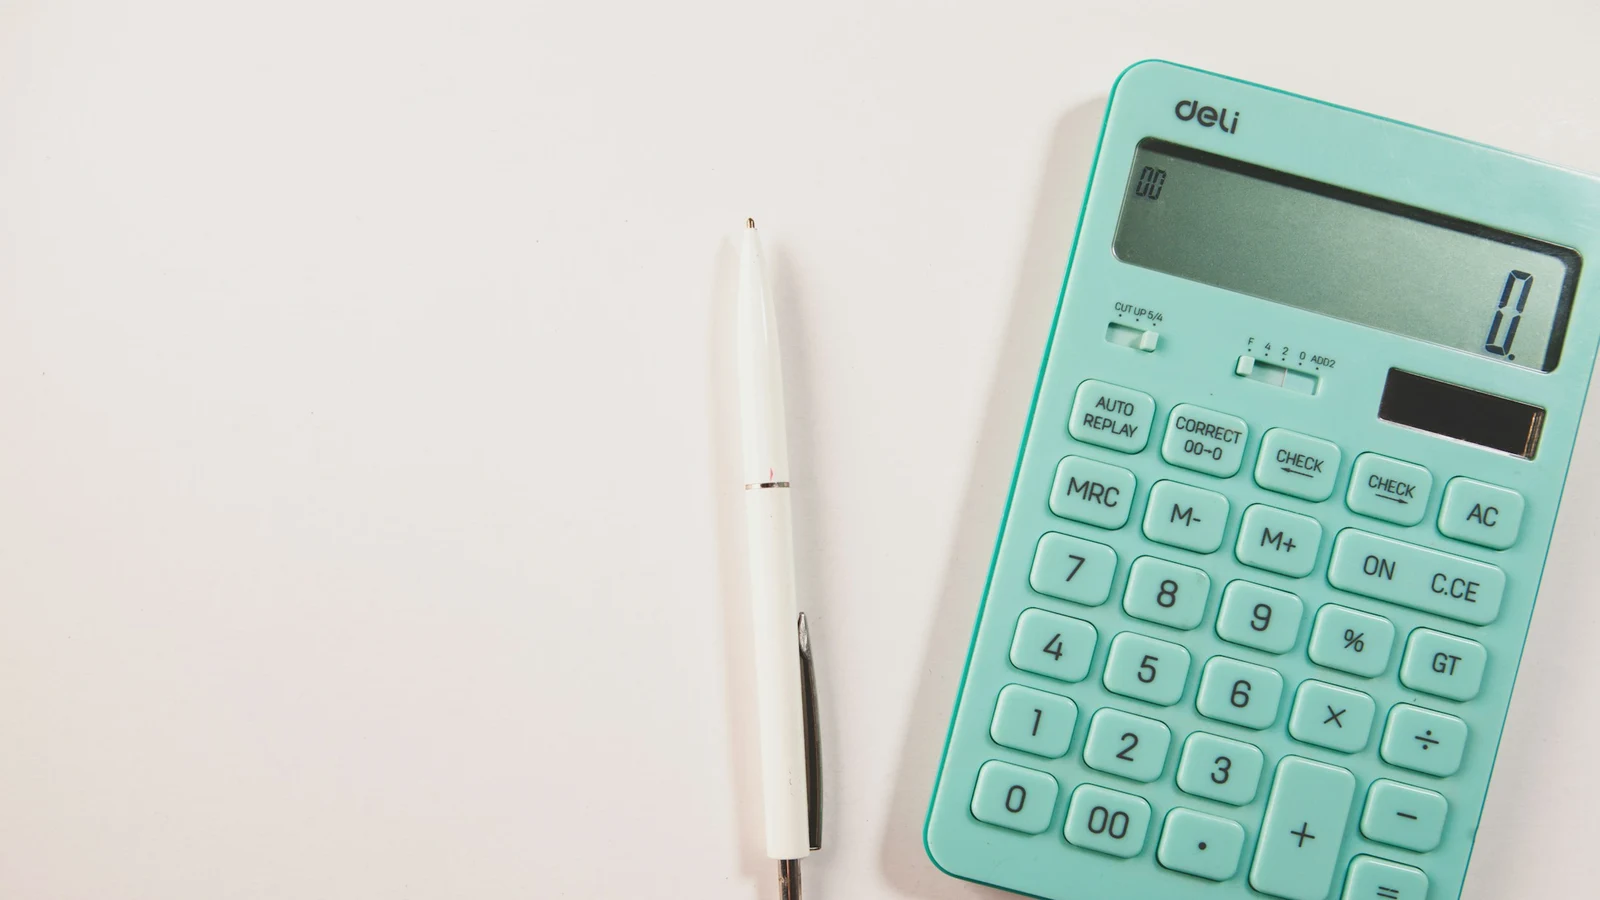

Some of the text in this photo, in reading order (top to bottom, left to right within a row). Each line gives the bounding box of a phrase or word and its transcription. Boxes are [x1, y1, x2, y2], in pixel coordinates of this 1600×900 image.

[1174, 100, 1240, 135] deli
[1135, 165, 1167, 201] 00
[1115, 302, 1163, 322] CUT UP 5/4
[1247, 337, 1336, 369] F 4 2 0 ADD2
[1095, 396, 1135, 417] AUTO
[1083, 413, 1138, 438] REPLAY
[1175, 416, 1243, 445] CORRECT
[1276, 448, 1324, 474] CHECK
[1067, 477, 1119, 507] MRC
[1368, 474, 1416, 500] CHECK
[1170, 504, 1201, 526] M-
[1466, 504, 1498, 527] AC
[1261, 528, 1296, 552] M+
[1066, 555, 1085, 582] 7
[1363, 555, 1479, 602] ON C.CE
[1157, 580, 1178, 608] 8
[1251, 604, 1272, 631] 9
[1043, 634, 1062, 661] 4
[1344, 629, 1364, 652] %
[1138, 655, 1158, 683] 5
[1432, 652, 1462, 675] GT
[1230, 680, 1251, 708] 6
[1032, 709, 1042, 736] 1
[1116, 733, 1138, 761] 2
[1211, 756, 1231, 784] 3
[1005, 785, 1026, 813] 0
[1087, 806, 1129, 839] 00
